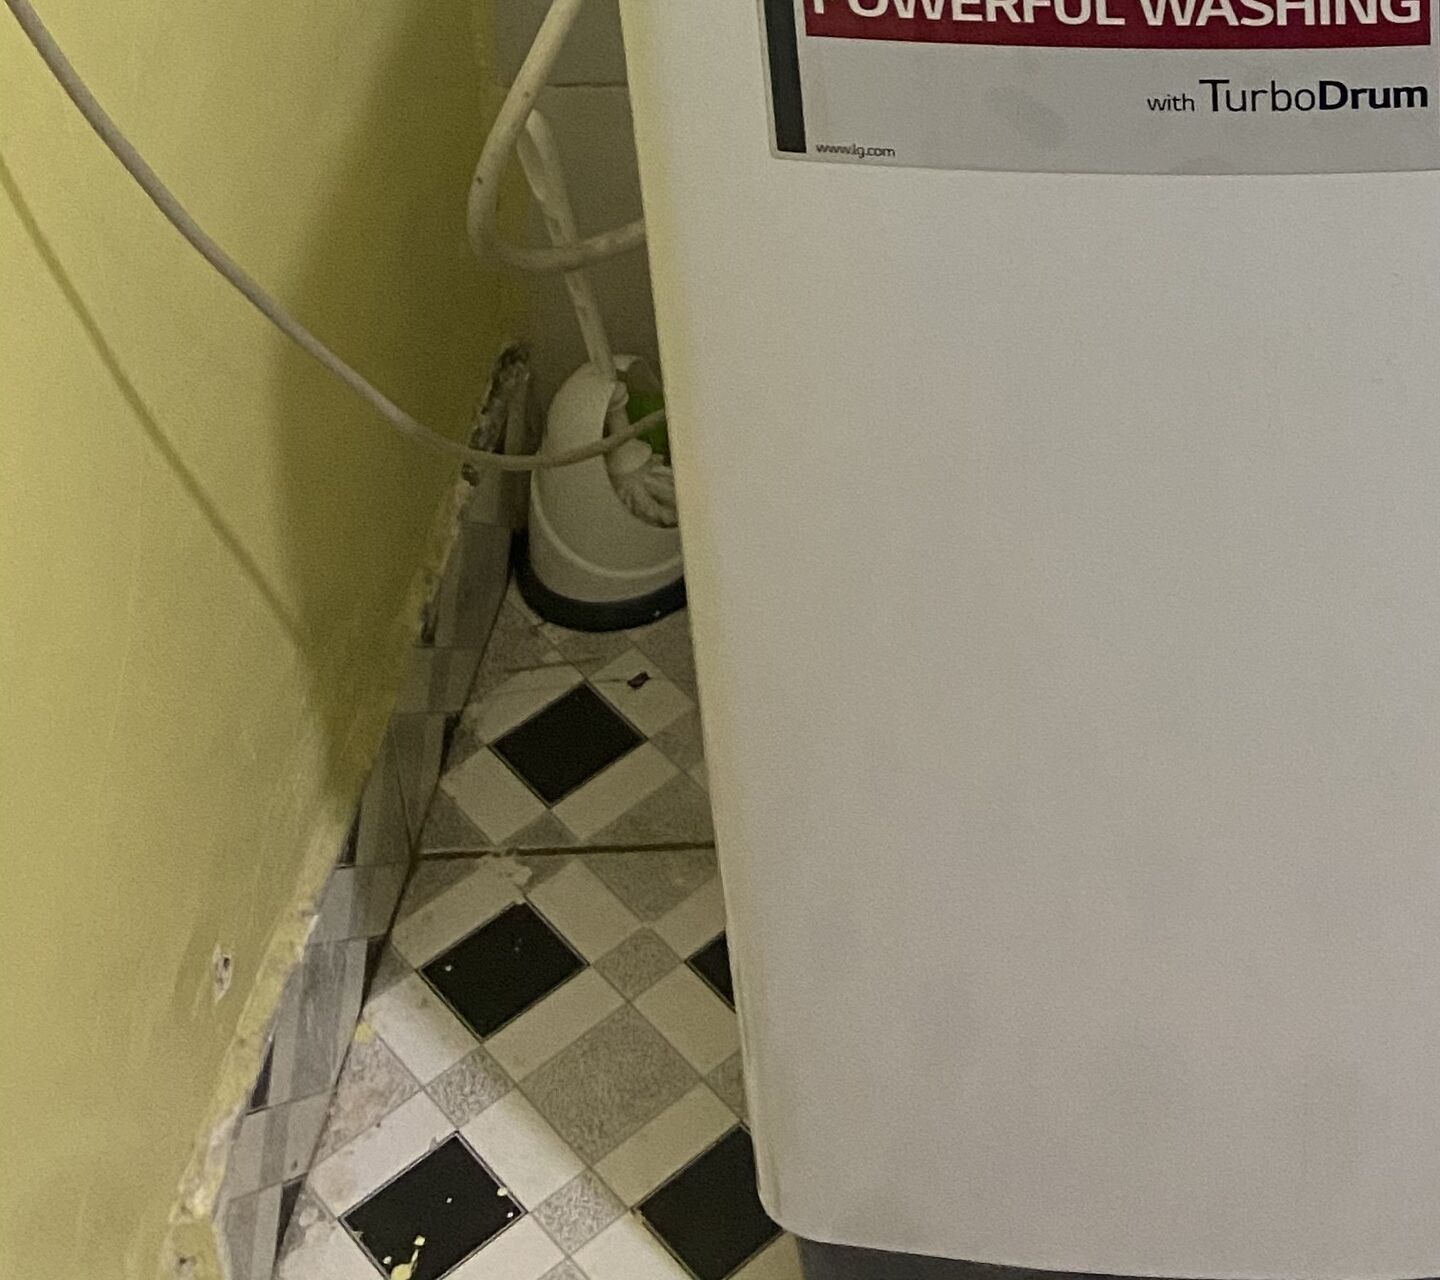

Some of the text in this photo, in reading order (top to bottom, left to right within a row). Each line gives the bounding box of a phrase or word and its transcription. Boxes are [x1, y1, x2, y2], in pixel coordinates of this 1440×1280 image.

[1147, 79, 1428, 112] with TurboDrum
[816, 143, 896, 159] www.lg.com
